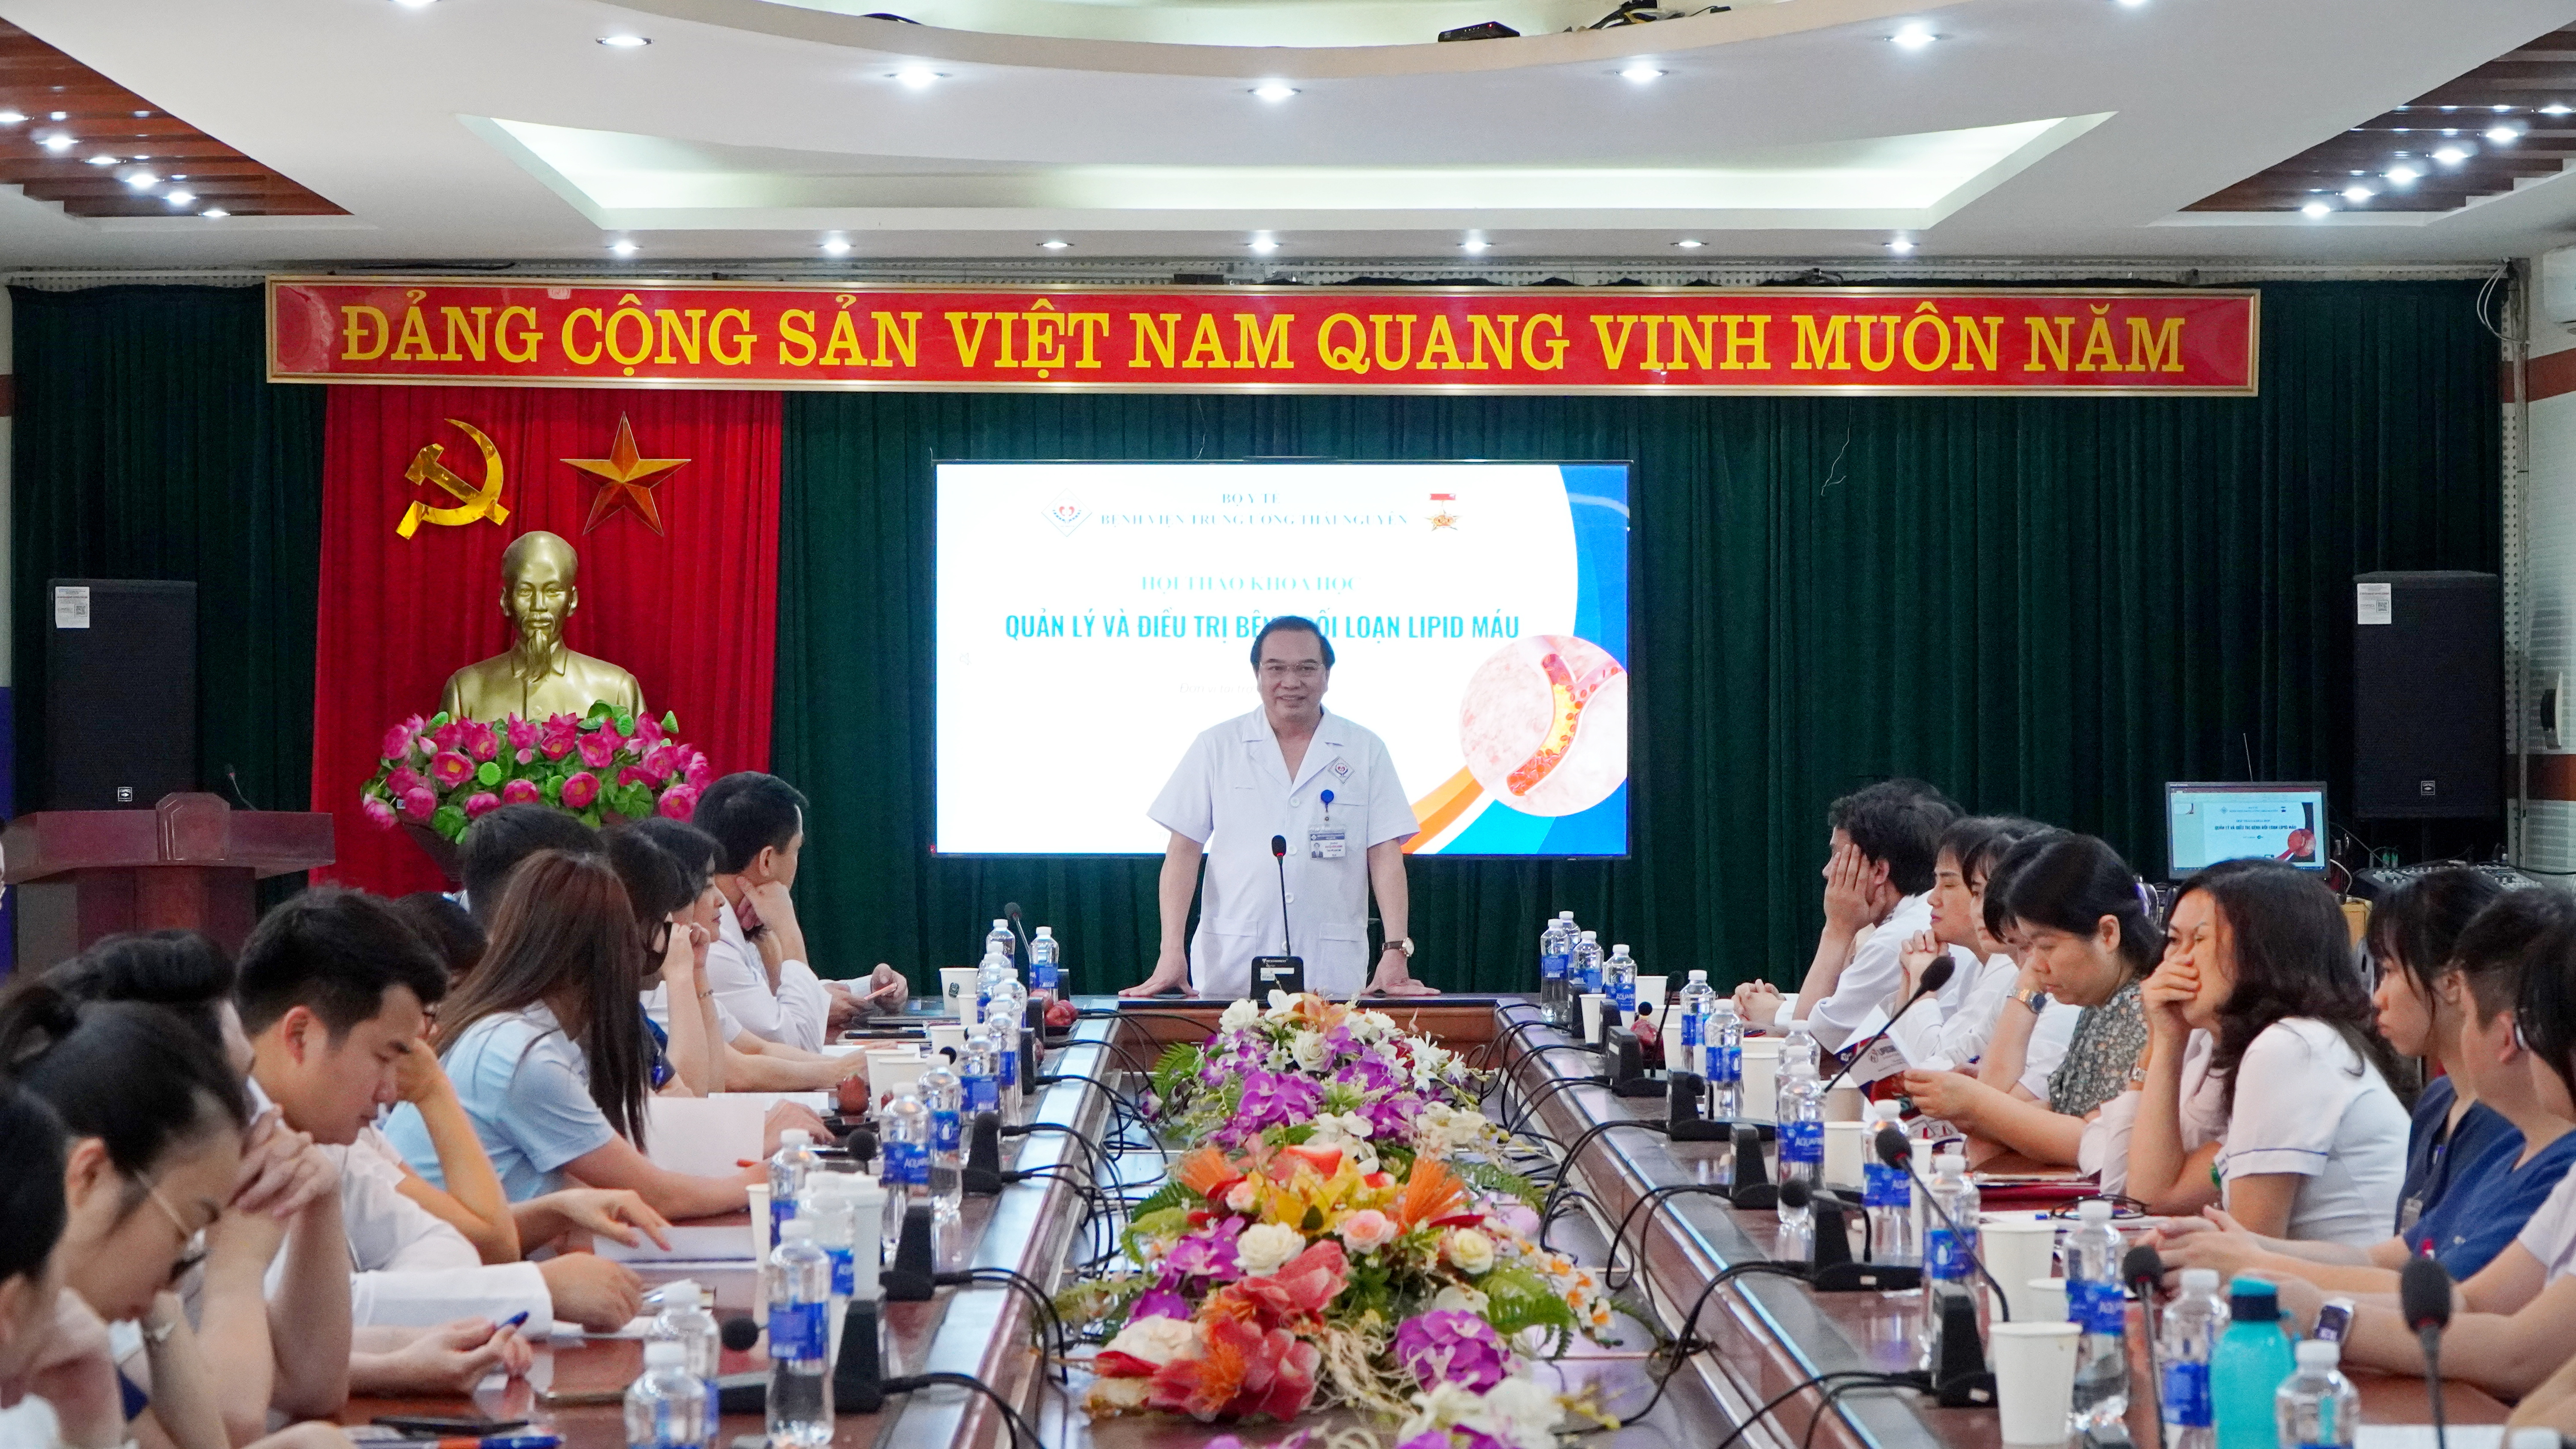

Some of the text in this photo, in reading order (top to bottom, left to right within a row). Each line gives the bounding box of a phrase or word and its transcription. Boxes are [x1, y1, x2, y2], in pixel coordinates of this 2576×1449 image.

[342, 291, 2185, 379] ĐẢNG CỘNG SẢN VIỆT NAM QUANG VINH MUÔN NĂM
[1250, 576, 1311, 591] KHOA
[1005, 608, 1064, 641] QUẢN
[1072, 608, 1096, 638] LÝ
[1103, 608, 1130, 638] VÀ
[1137, 607, 1186, 638] ĐIỀU
[1193, 615, 1228, 643] TRỊ
[1346, 616, 1400, 643] LOẠN
[1409, 616, 1464, 638] LIPID
[1472, 608, 1519, 638] MÁU
